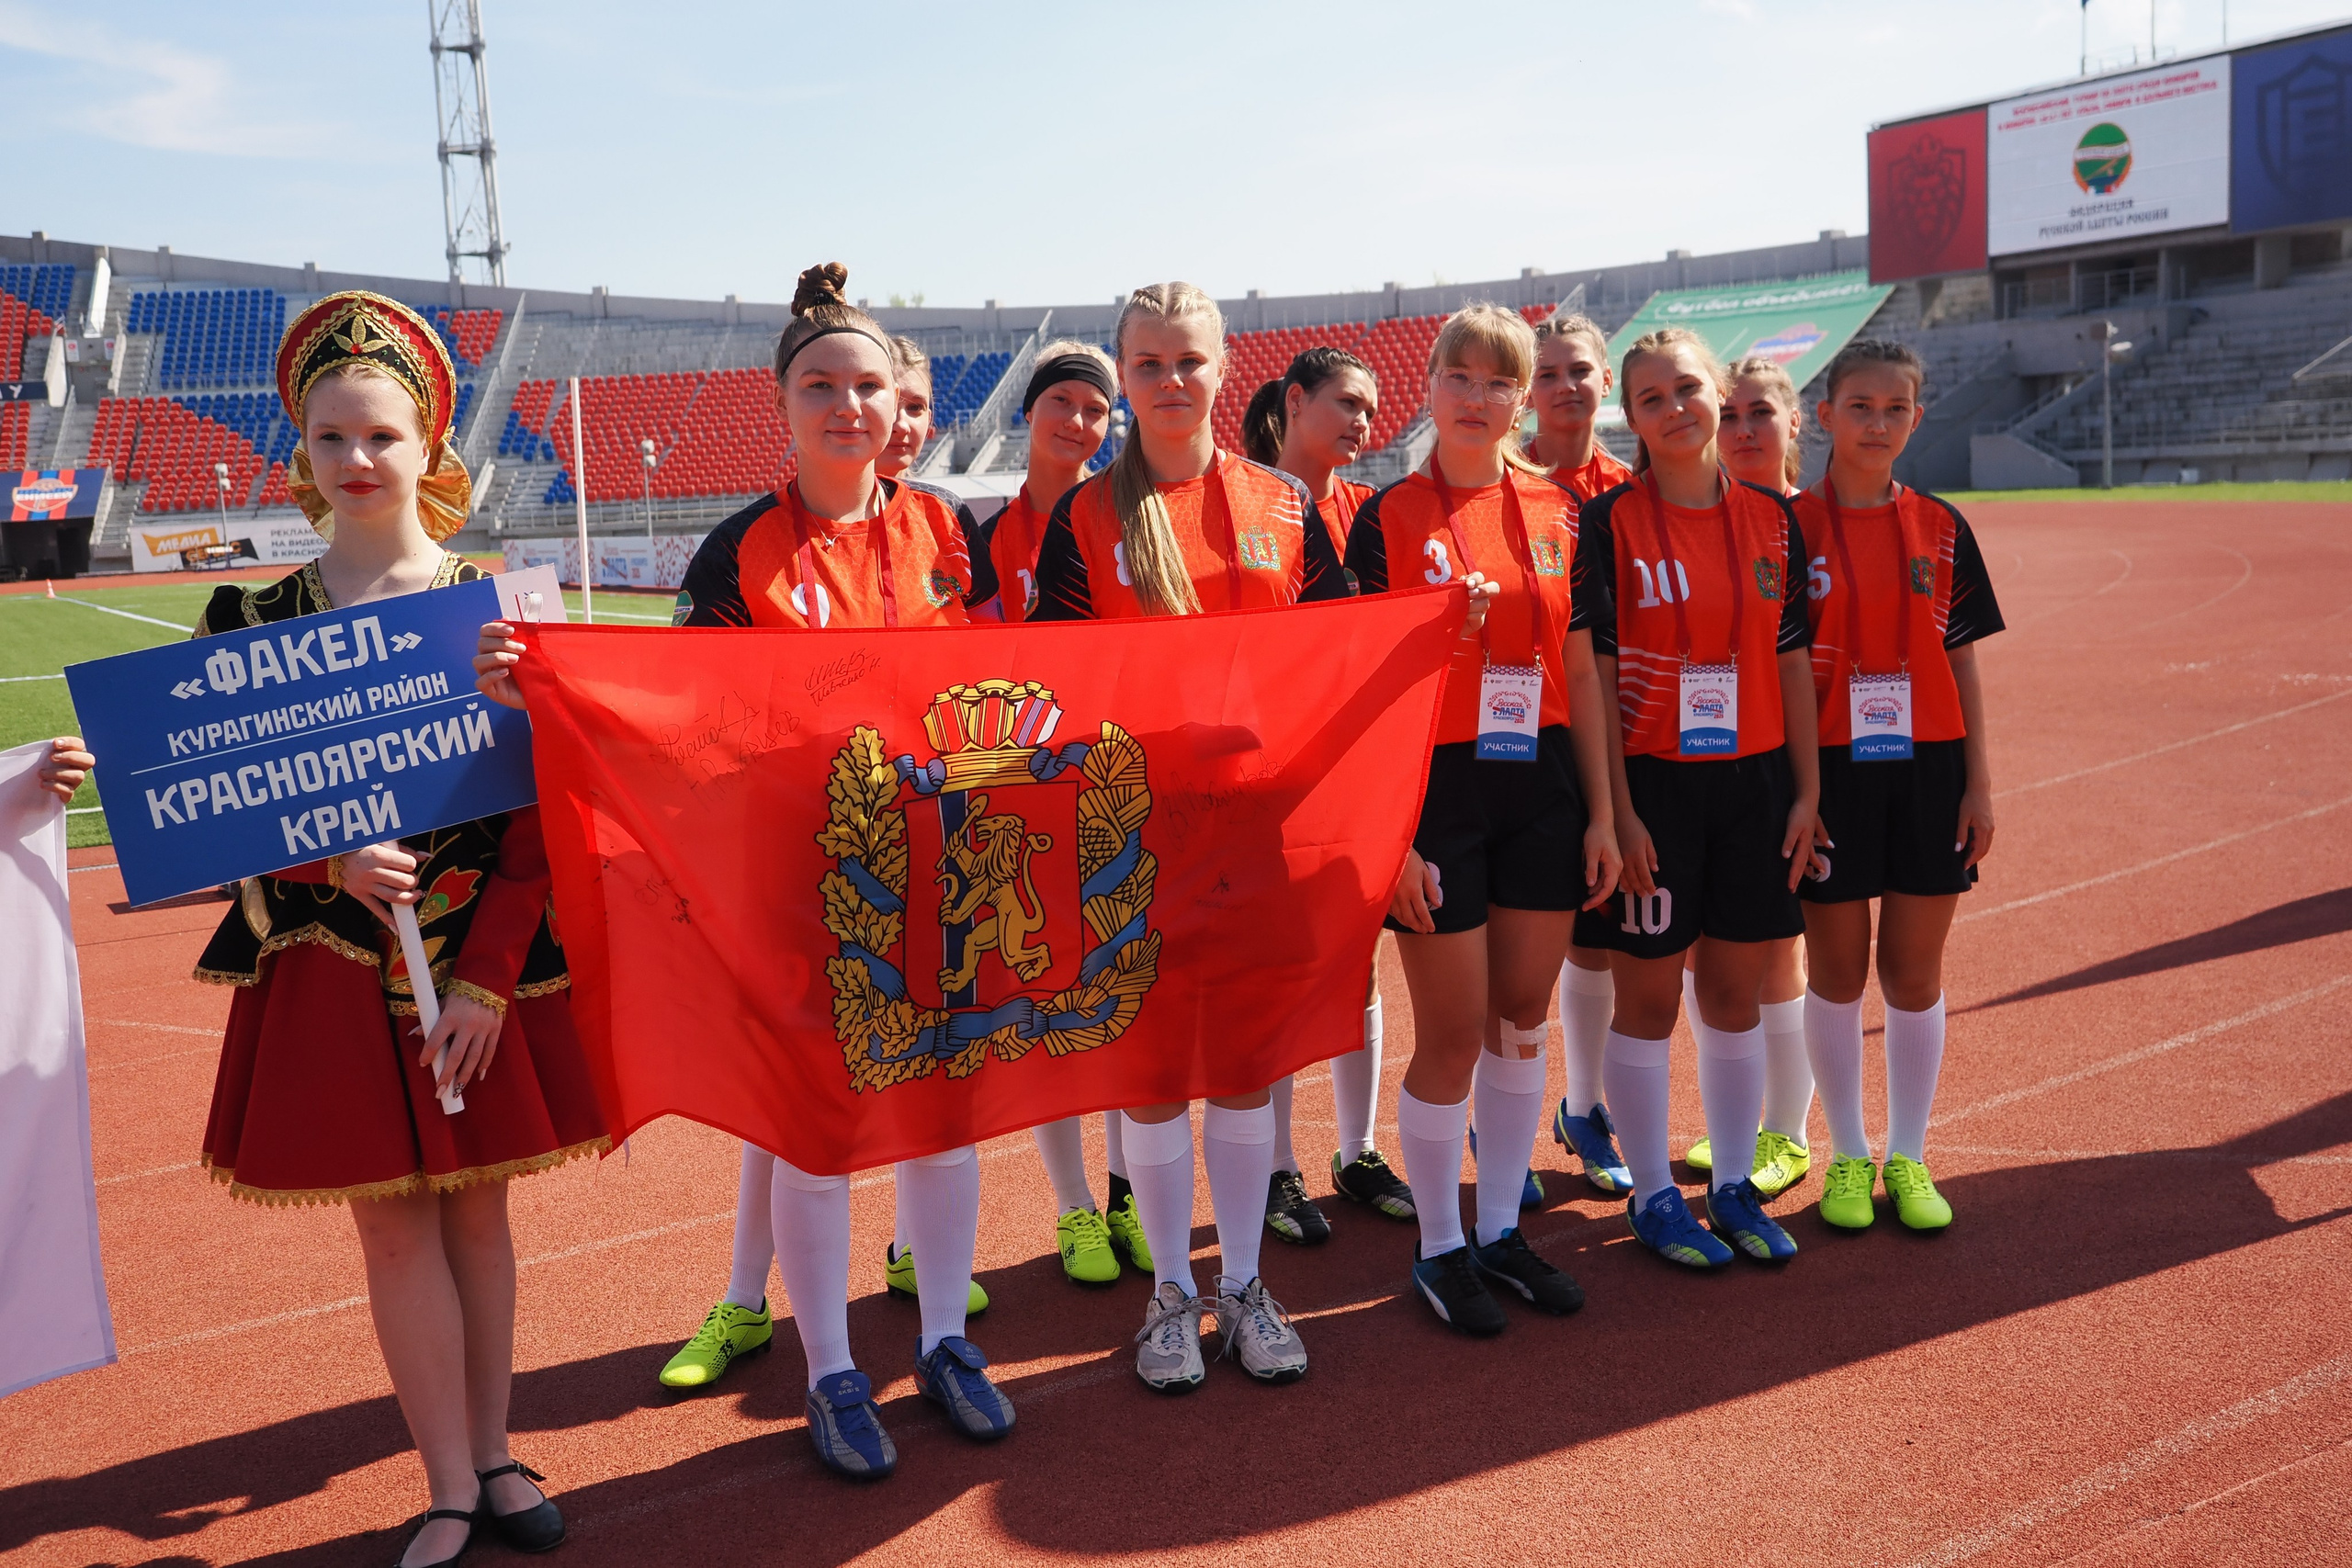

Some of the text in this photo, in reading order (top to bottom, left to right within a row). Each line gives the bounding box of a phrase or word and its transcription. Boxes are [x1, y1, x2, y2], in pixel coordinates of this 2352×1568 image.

[271, 528, 316, 537] РЕКЛАМ
[271, 537, 326, 547] НА ВИДЕО
[1424, 538, 1452, 584] 3
[1634, 558, 1690, 608] 10
[1807, 556, 1831, 600] 5
[170, 615, 424, 700] «ФАКЕЛ»
[167, 671, 449, 757] КУРАГИНСКИЙ РАЙОН
[145, 702, 496, 829] КРАСНОЯРСКИЙ
[1484, 742, 1530, 752] УЧАСТНИК
[1687, 738, 1730, 747] УЧАСТНИК
[1859, 744, 1905, 753] УЧАСТНИК
[279, 783, 401, 856] КРАЙ
[1619, 880, 1672, 935] 10
